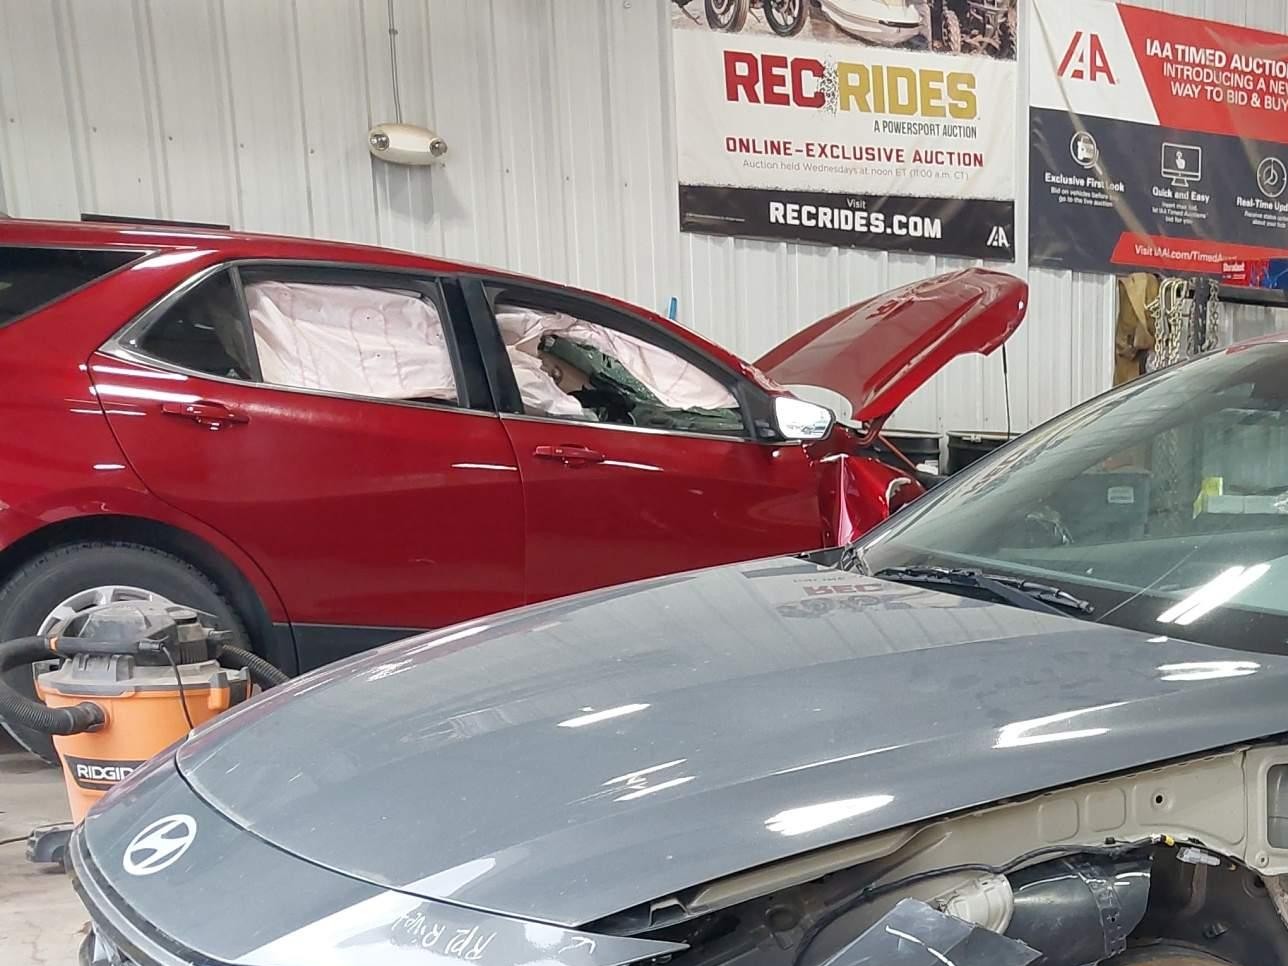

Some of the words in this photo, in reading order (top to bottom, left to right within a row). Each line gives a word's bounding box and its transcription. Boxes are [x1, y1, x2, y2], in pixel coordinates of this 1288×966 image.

[1146, 38, 1172, 60] IAA
[1174, 44, 1227, 68] TIMED
[723, 50, 826, 108] REC
[837, 61, 977, 120] RIDES
[1163, 61, 1254, 90] INTRODUCING
[1256, 77, 1266, 92] A
[1170, 81, 1201, 99] WAY
[1204, 86, 1224, 102] TO
[1226, 89, 1248, 106] BID
[1250, 93, 1261, 108] &
[873, 119, 880, 133] A
[882, 120, 940, 137] POWERSPORT
[942, 124, 977, 140] AUCTION
[725, 136, 905, 163] ONLINE-EXCLUSIVE
[912, 149, 984, 168] AUCTION
[743, 159, 779, 169] Auction
[780, 161, 801, 171] held
[802, 162, 858, 175] Wednesdays
[871, 168, 893, 176] noon
[1045, 172, 1085, 187] Exclusive
[1086, 176, 1105, 189] First
[846, 197, 866, 209] Visit
[1152, 186, 1173, 198] Quick
[1174, 191, 1189, 200] and
[1191, 191, 1210, 204] Easy
[1236, 196, 1273, 210] Real-Time
[769, 201, 942, 239] RECRIDES.COM
[1134, 244, 1153, 256] Visit
